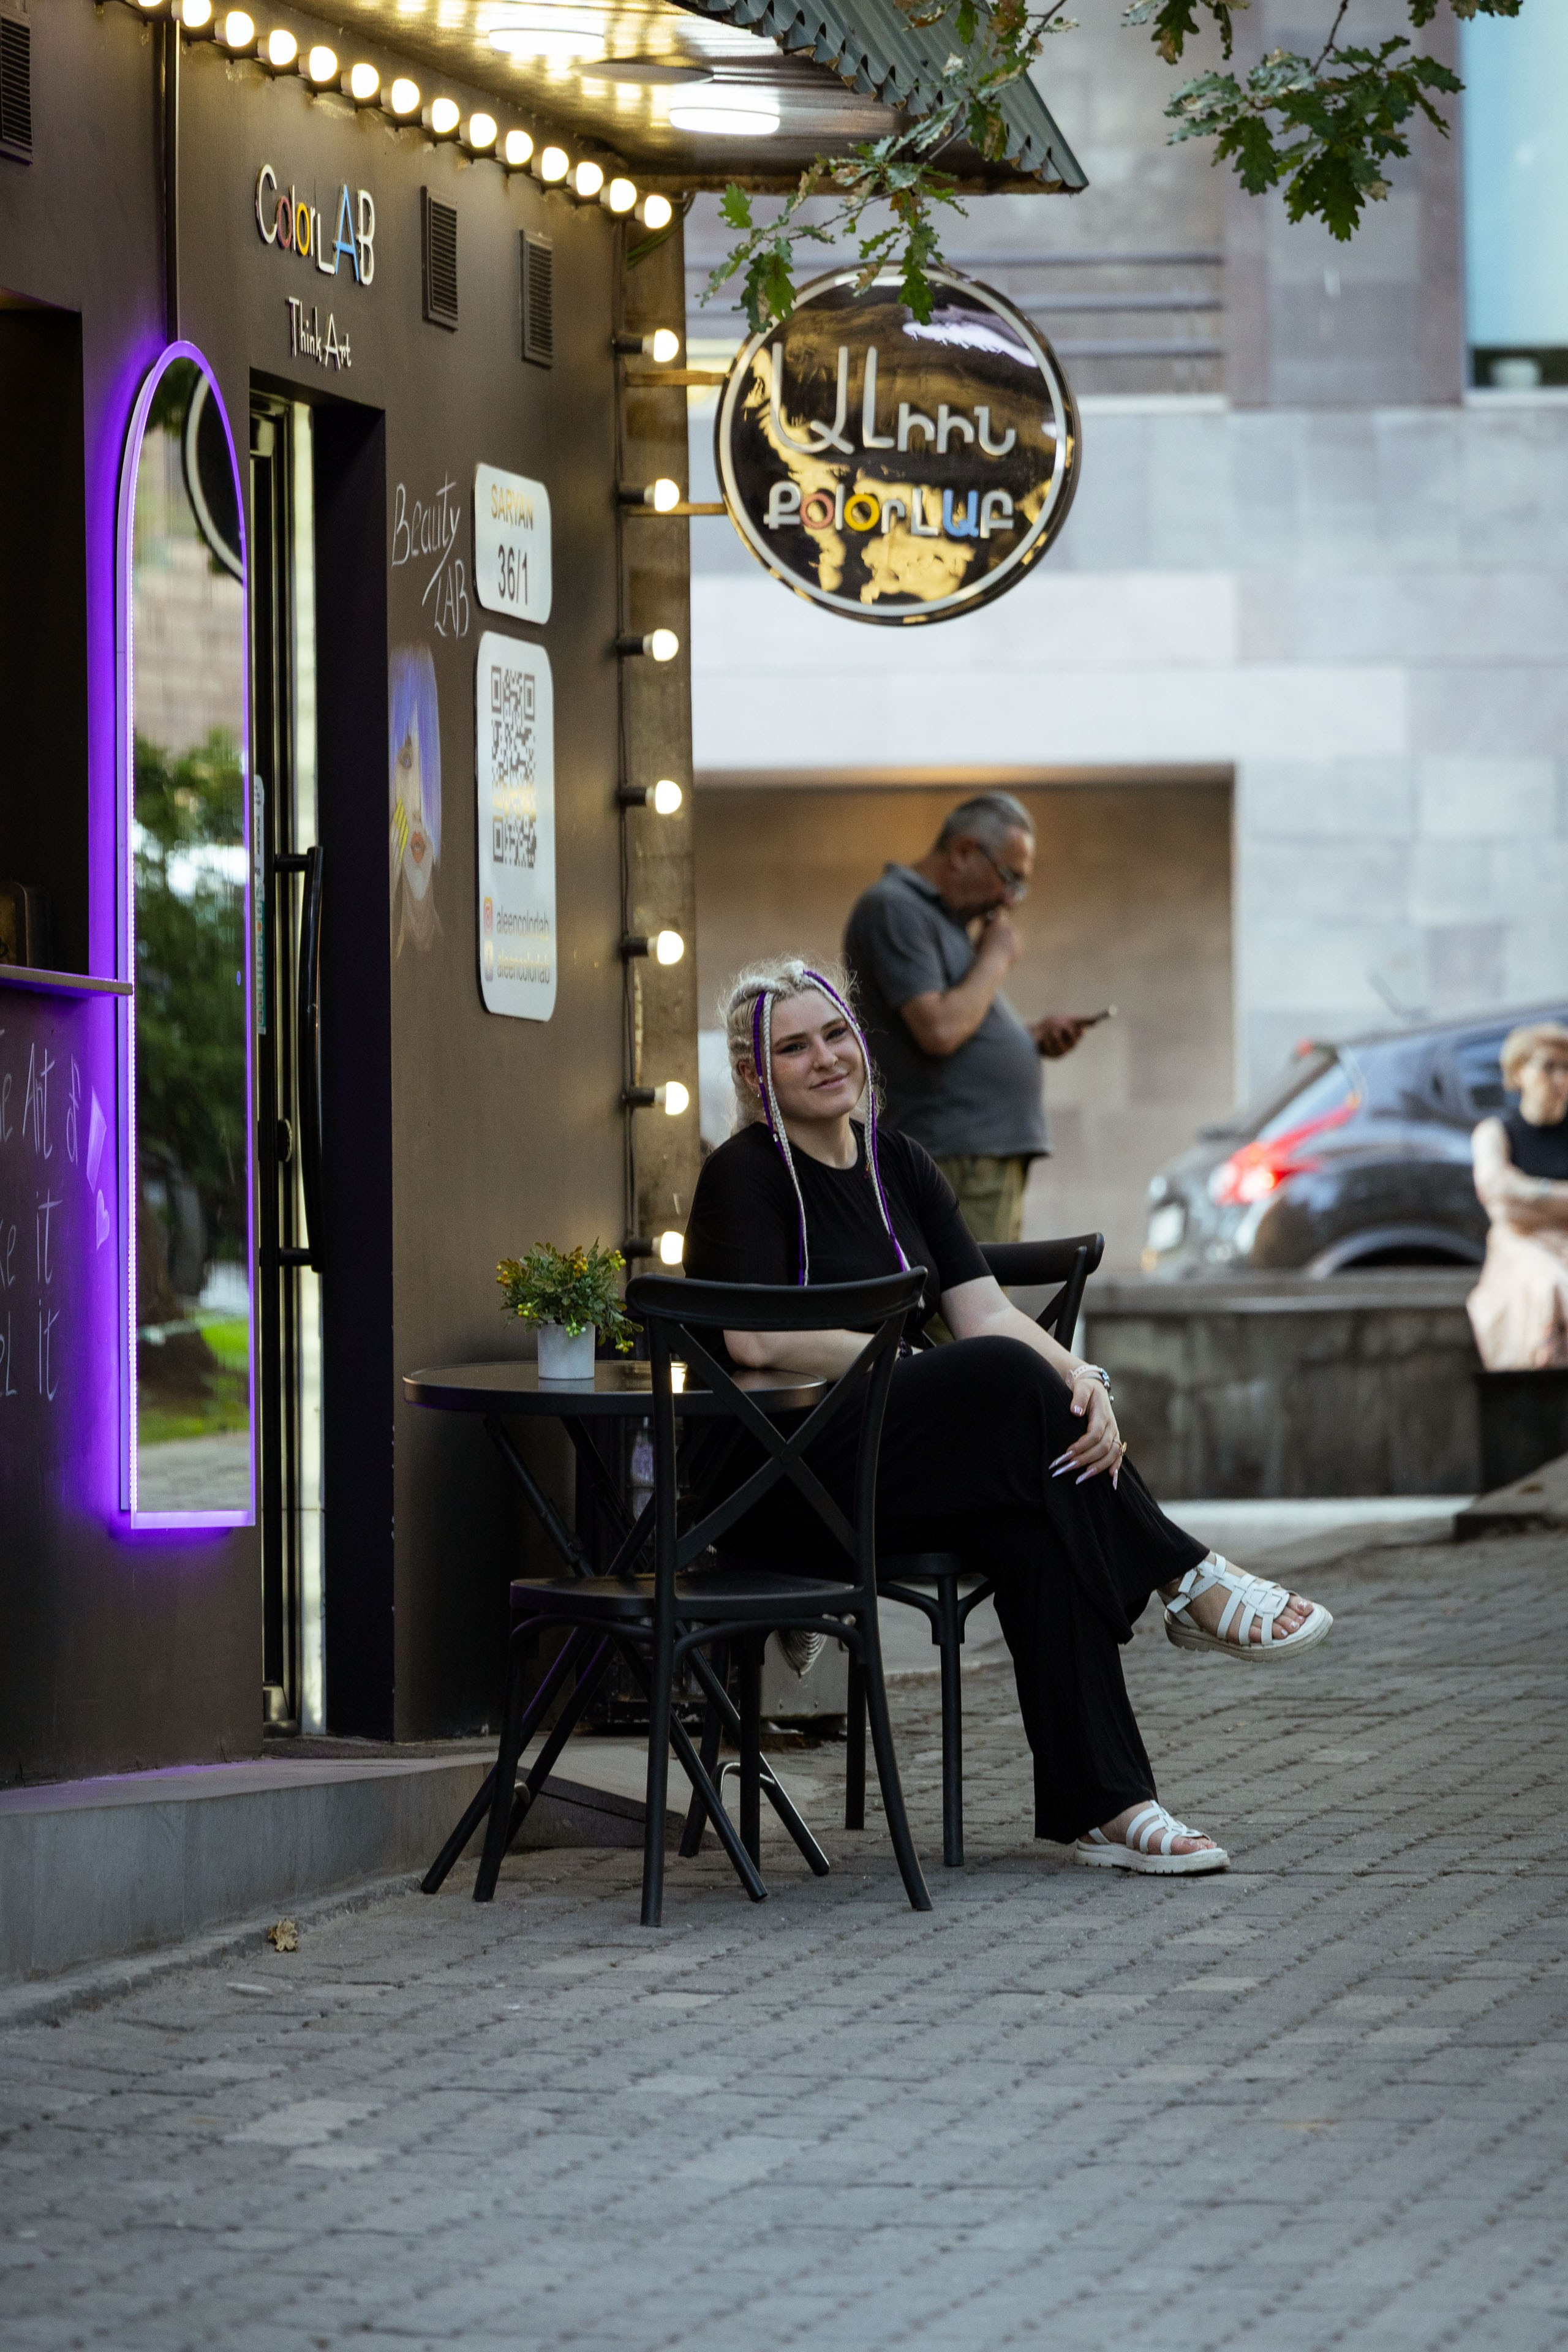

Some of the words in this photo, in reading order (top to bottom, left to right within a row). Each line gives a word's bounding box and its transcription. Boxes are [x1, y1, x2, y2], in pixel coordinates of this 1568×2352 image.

[255, 164, 374, 285] ColorLAB
[287, 296, 322, 363] Think
[325, 313, 351, 370] Art
[391, 470, 460, 606] Beauty
[491, 484, 533, 530] SARYAN
[434, 559, 469, 639] LAB
[497, 544, 528, 606] 36/1
[497, 905, 549, 937] aleencolorlab
[497, 949, 549, 984] aleencolorlab
[22, 1042, 55, 1160] Art
[36, 1188, 62, 1285] it
[38, 1298, 60, 1401] it
